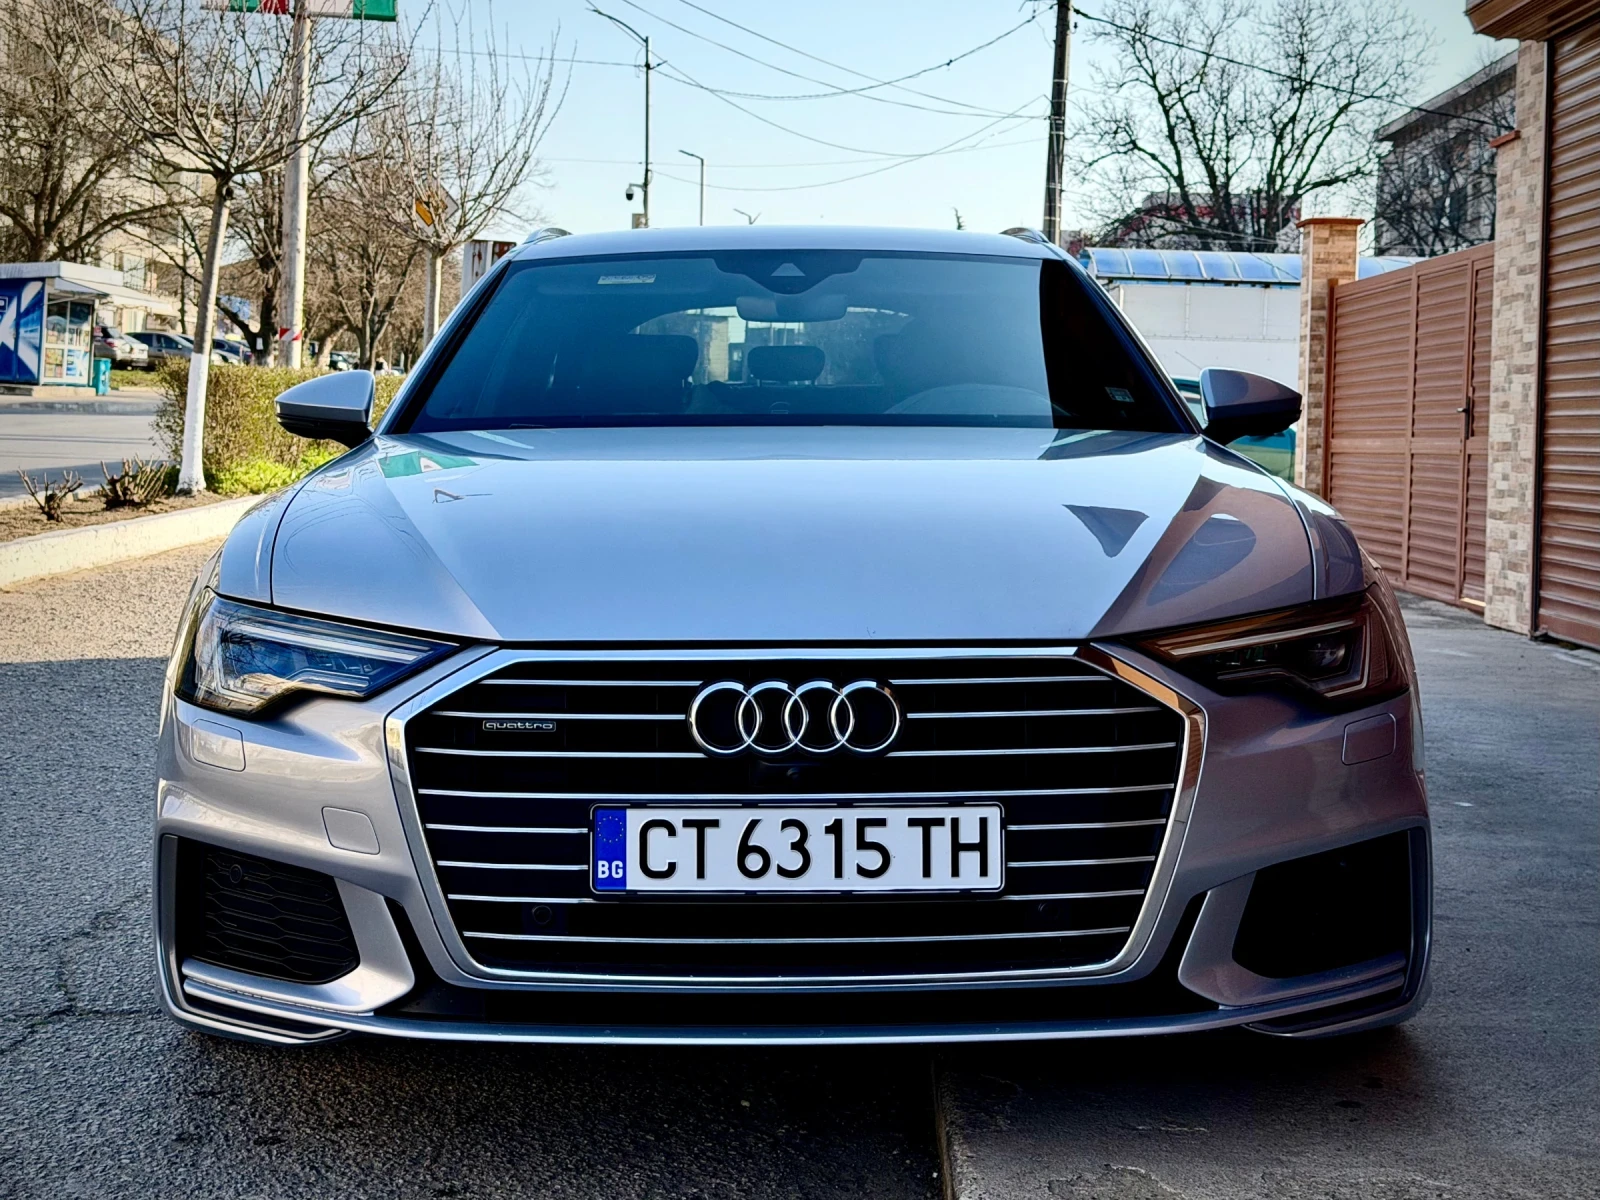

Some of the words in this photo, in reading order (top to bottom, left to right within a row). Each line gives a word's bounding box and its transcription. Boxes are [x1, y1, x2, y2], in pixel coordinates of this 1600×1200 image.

[485, 721, 554, 731] quattro
[638, 817, 721, 881] CT
[736, 817, 892, 881] 6315
[907, 816, 990, 880] TH
[597, 860, 624, 879] BG
